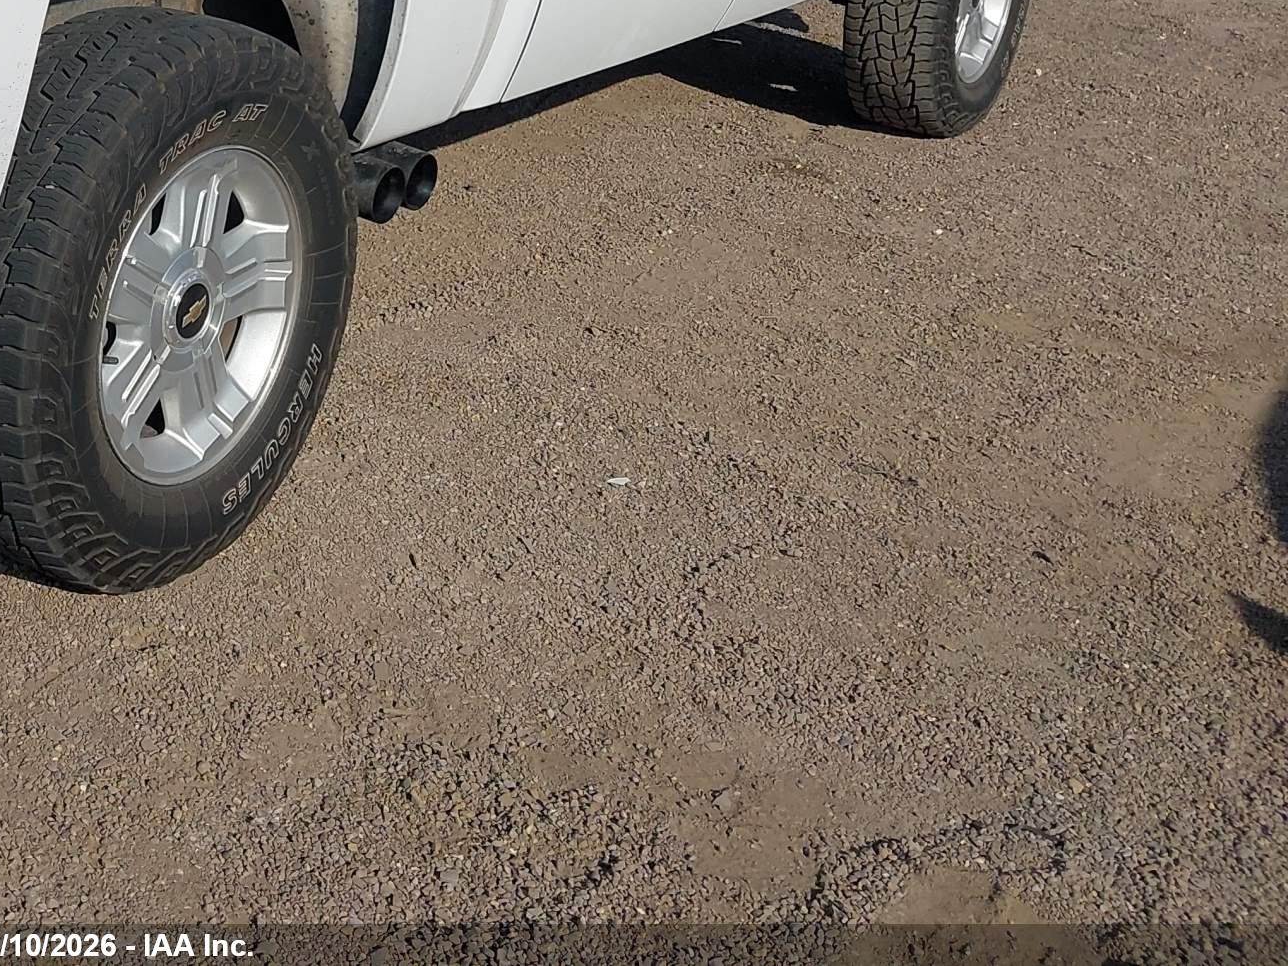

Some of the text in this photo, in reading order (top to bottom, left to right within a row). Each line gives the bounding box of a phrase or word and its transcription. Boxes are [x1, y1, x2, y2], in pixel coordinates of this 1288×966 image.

[89, 103, 268, 321] TERRA TRAC AT
[222, 343, 323, 515] HERCULES
